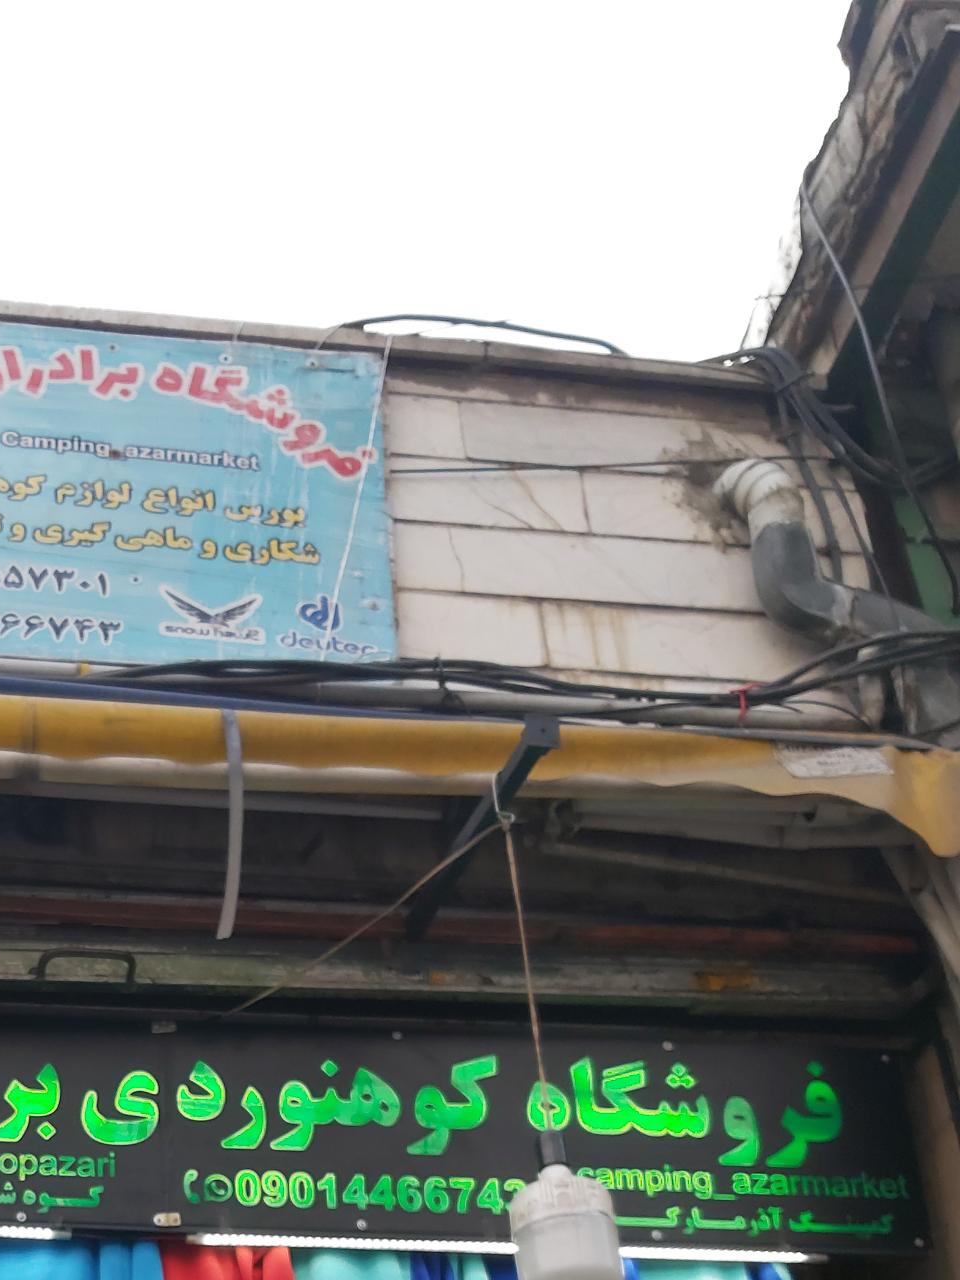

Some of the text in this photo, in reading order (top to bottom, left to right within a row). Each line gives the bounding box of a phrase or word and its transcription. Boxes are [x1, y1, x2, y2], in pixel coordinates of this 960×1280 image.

[153, 365, 376, 479] فروشگاه
[55, 481, 132, 510] لوازم
[141, 487, 215, 517] انواع
[8, 523, 26, 543] و
[33, 522, 110, 549] گیری
[114, 526, 194, 553] ماهی
[200, 539, 218, 559] و
[224, 537, 320, 566] شکاری
[280, 630, 375, 656] deuter
[80, 1053, 499, 1157] کوهنوردی
[525, 1055, 842, 1169] فروشگاه
[21, 1184, 106, 1213] کوه
